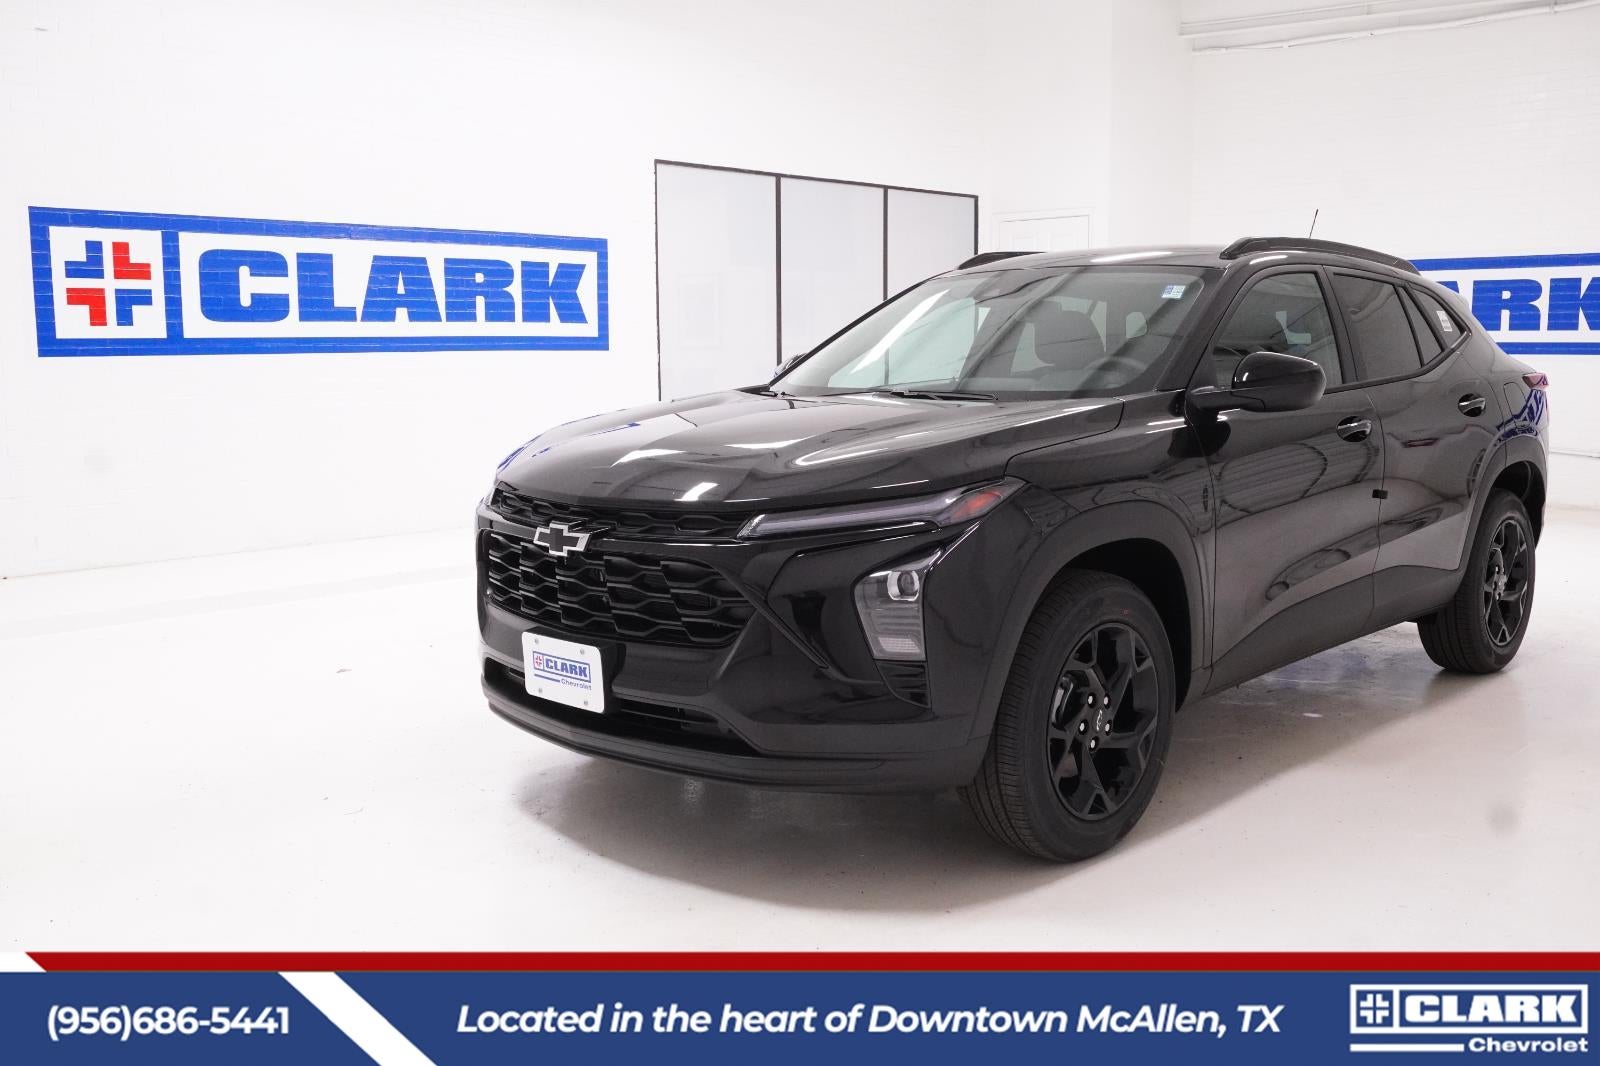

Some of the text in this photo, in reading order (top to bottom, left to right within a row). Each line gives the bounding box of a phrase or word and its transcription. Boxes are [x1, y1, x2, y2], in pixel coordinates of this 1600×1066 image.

[199, 248, 588, 324] CLARK
[1436, 277, 1600, 331] RK
[545, 658, 588, 678] CLARK
[560, 678, 592, 690] Chevrolet
